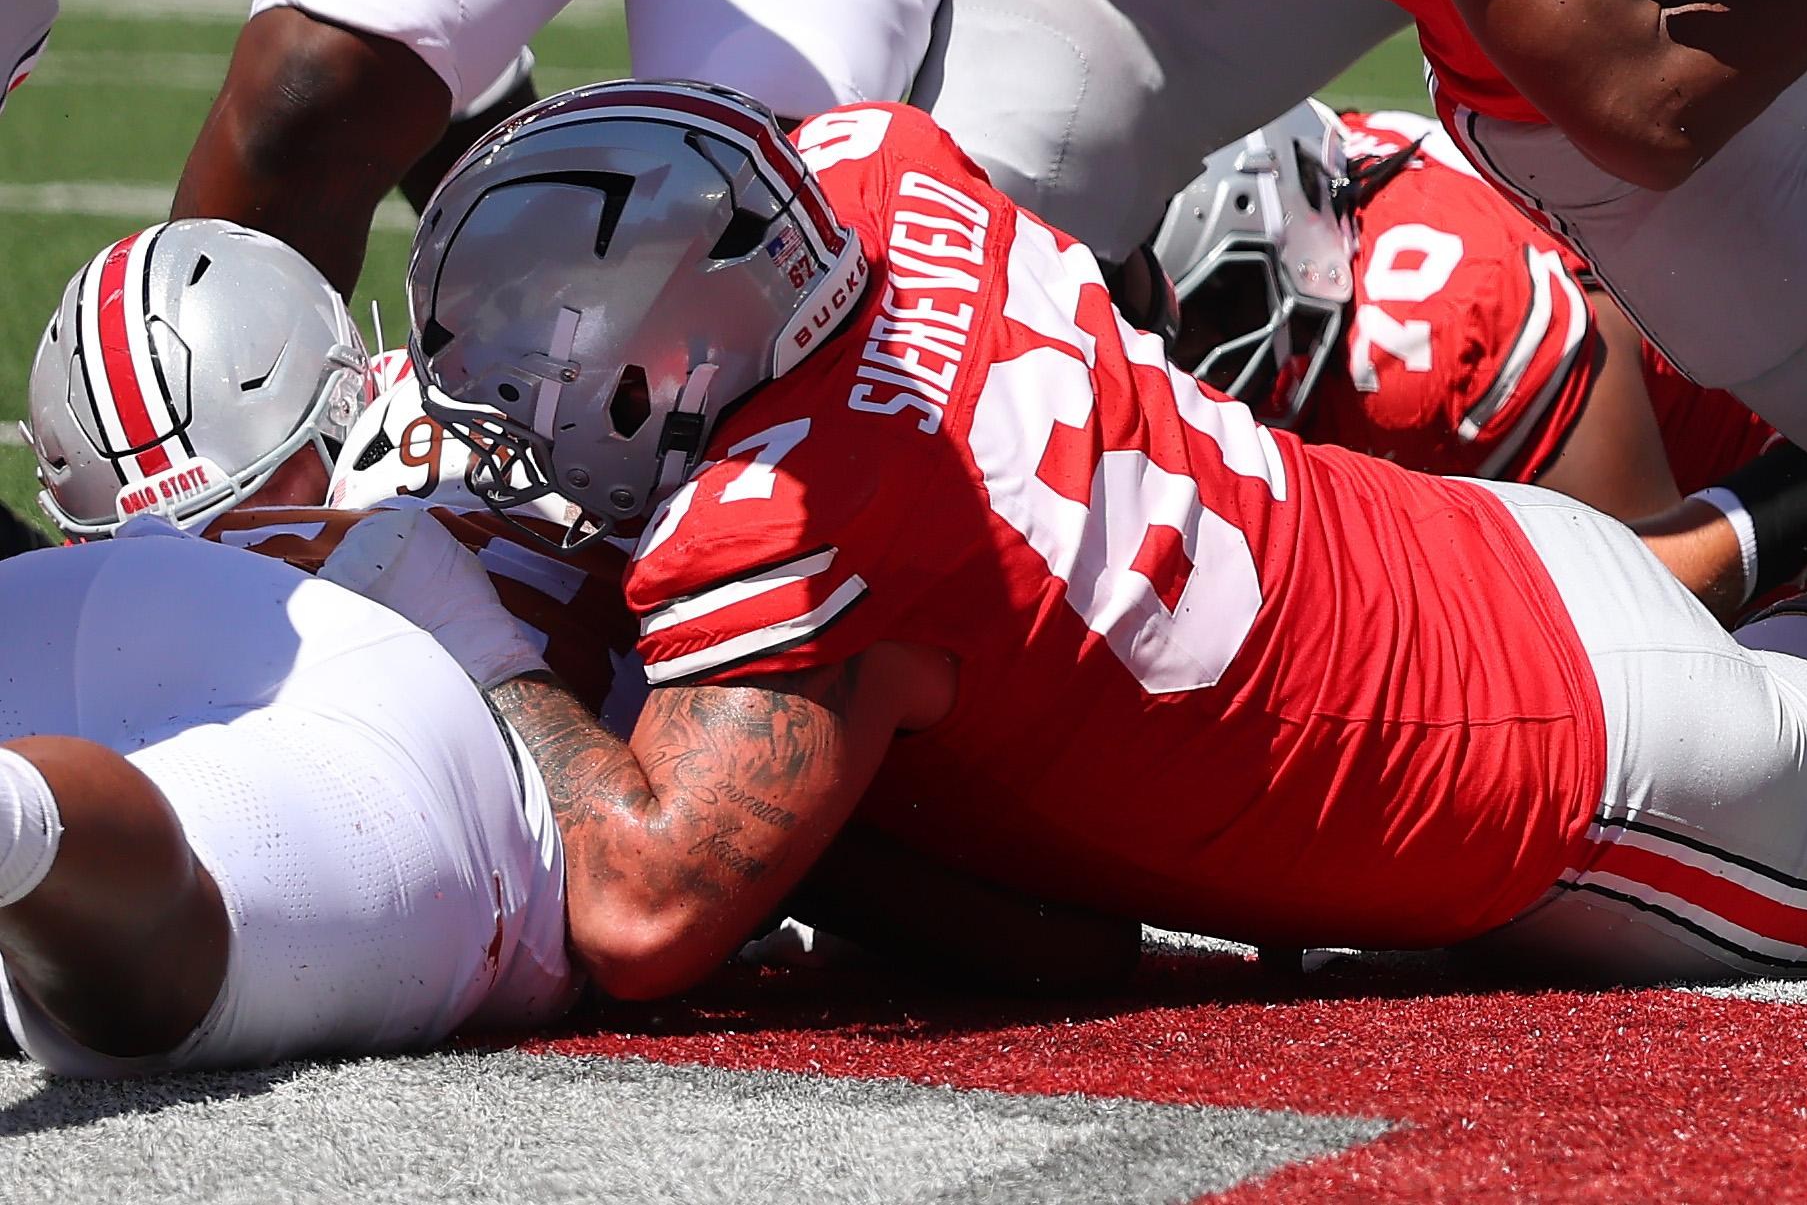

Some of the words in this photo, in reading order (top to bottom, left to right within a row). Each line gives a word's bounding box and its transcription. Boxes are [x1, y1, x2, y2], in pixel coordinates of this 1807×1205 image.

[788, 255, 815, 289] 67
[848, 171, 990, 435] SIEREVELD
[1350, 223, 1464, 393] 70
[120, 486, 158, 514] OHIO
[159, 465, 209, 499] STATE
[968, 204, 1288, 694] 67
